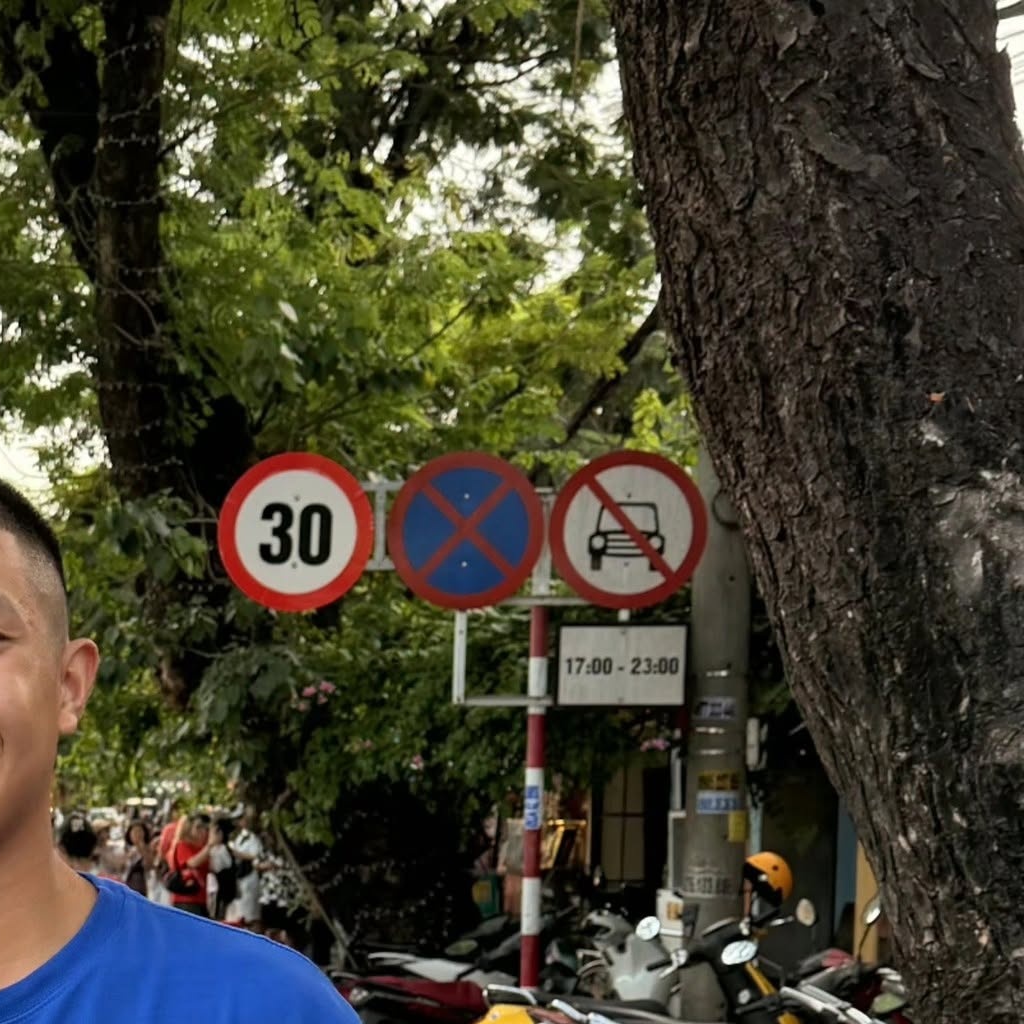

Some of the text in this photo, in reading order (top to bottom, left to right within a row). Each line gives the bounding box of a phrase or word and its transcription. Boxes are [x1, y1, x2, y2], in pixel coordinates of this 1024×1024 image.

[259, 502, 333, 566] 30
[566, 657, 613, 675] 17:00
[630, 656, 679, 675] 23:00
